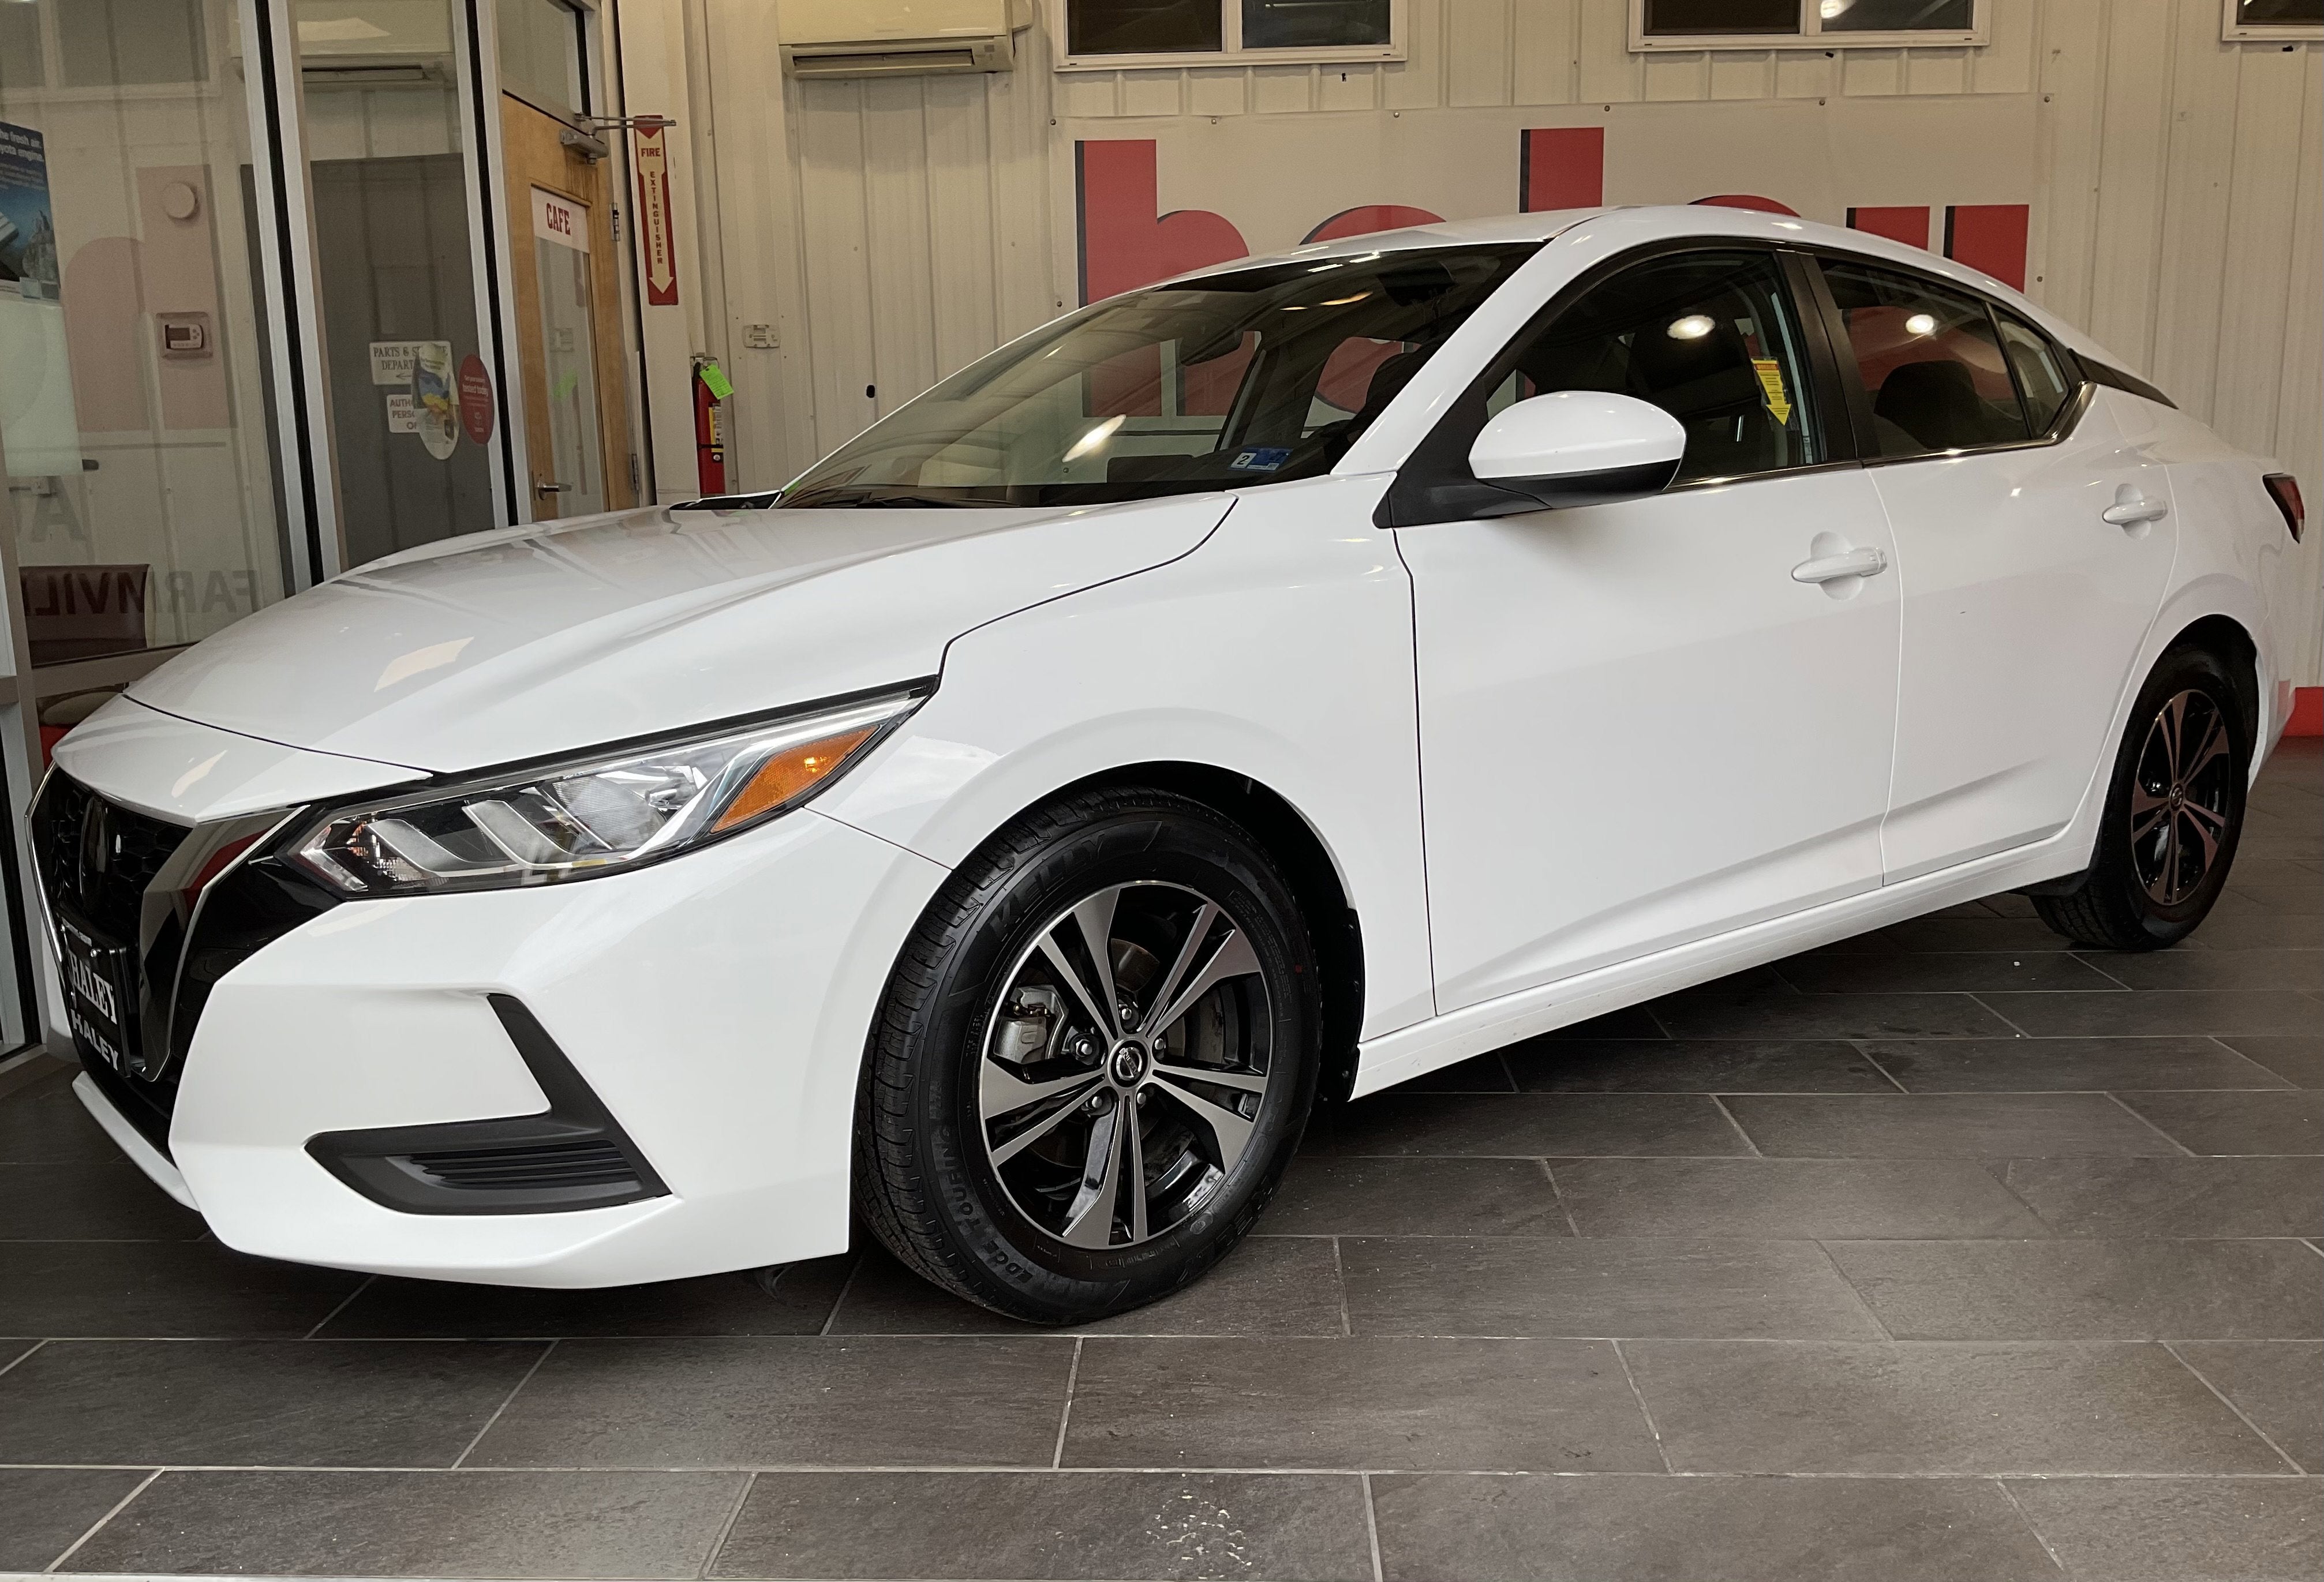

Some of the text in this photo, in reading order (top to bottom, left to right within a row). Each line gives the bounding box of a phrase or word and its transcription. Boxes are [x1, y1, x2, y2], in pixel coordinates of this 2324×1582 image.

[641, 147, 661, 158] FIRE
[546, 203, 571, 236] CAFE
[649, 171, 663, 265] EXTINGUISHER
[373, 347, 400, 358] PARTS
[390, 399, 414, 407] AUTH
[1237, 455, 1250, 465] 2
[988, 833, 1106, 944] KELLY
[66, 949, 118, 1026] HALEY
[70, 1009, 118, 1071] HALEY
[930, 1126, 981, 1238] TOURING
[979, 1241, 1034, 1284] EDGE
